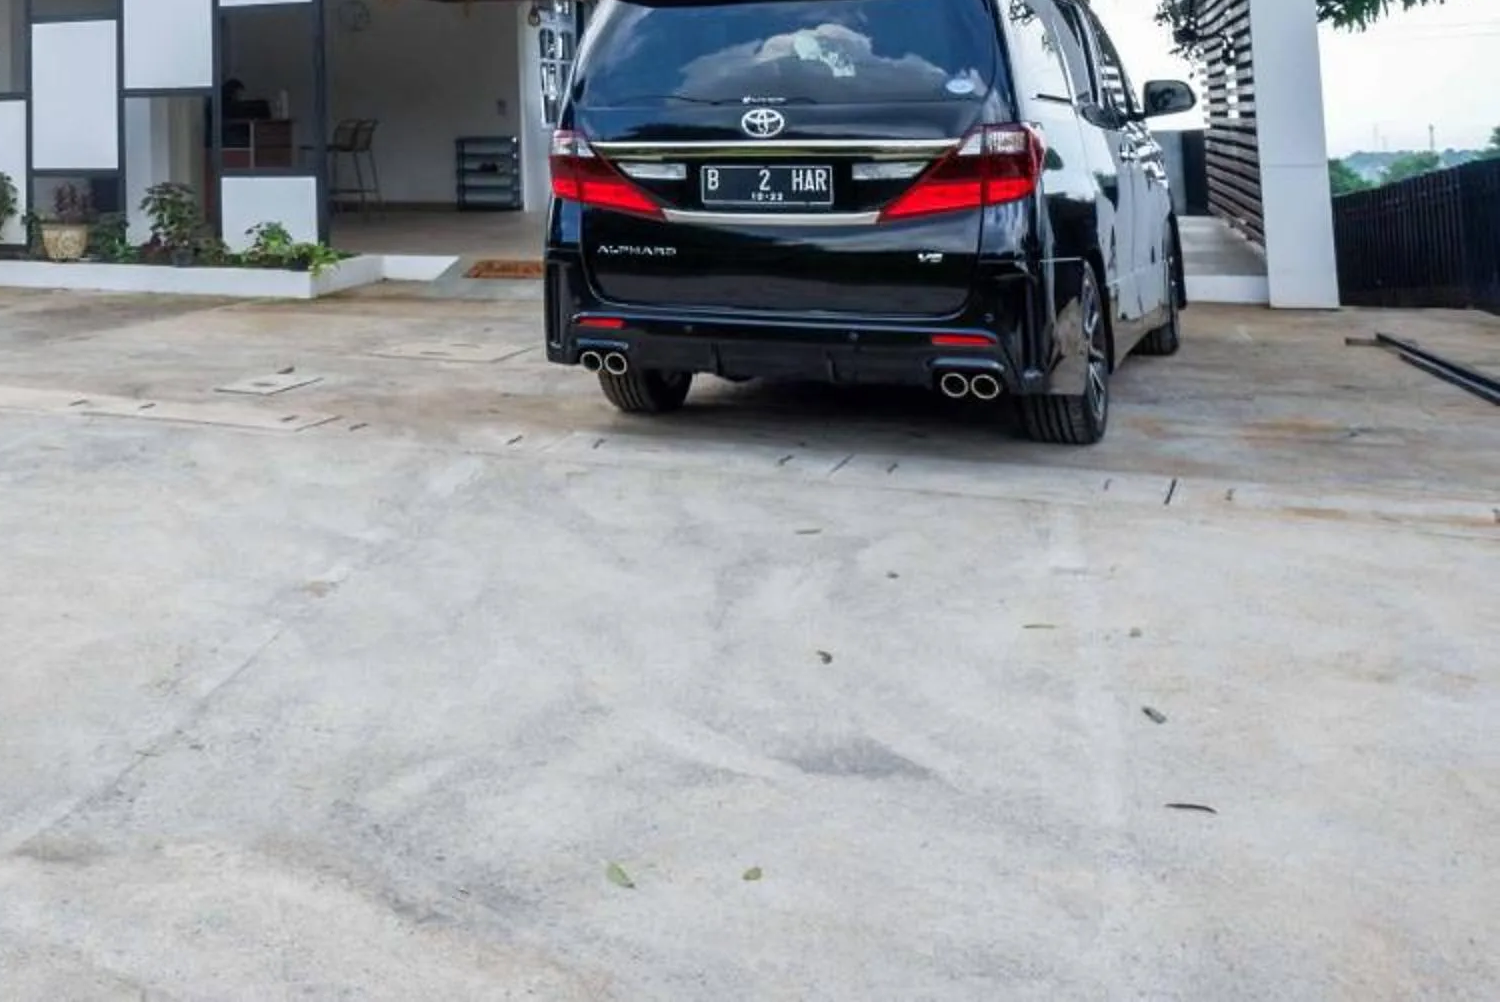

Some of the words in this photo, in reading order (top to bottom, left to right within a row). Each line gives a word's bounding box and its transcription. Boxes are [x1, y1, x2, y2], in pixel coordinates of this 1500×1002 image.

[707, 168, 720, 191] B
[758, 168, 771, 191] 2
[791, 168, 828, 191] HAR
[597, 245, 677, 256] ALPHARD
